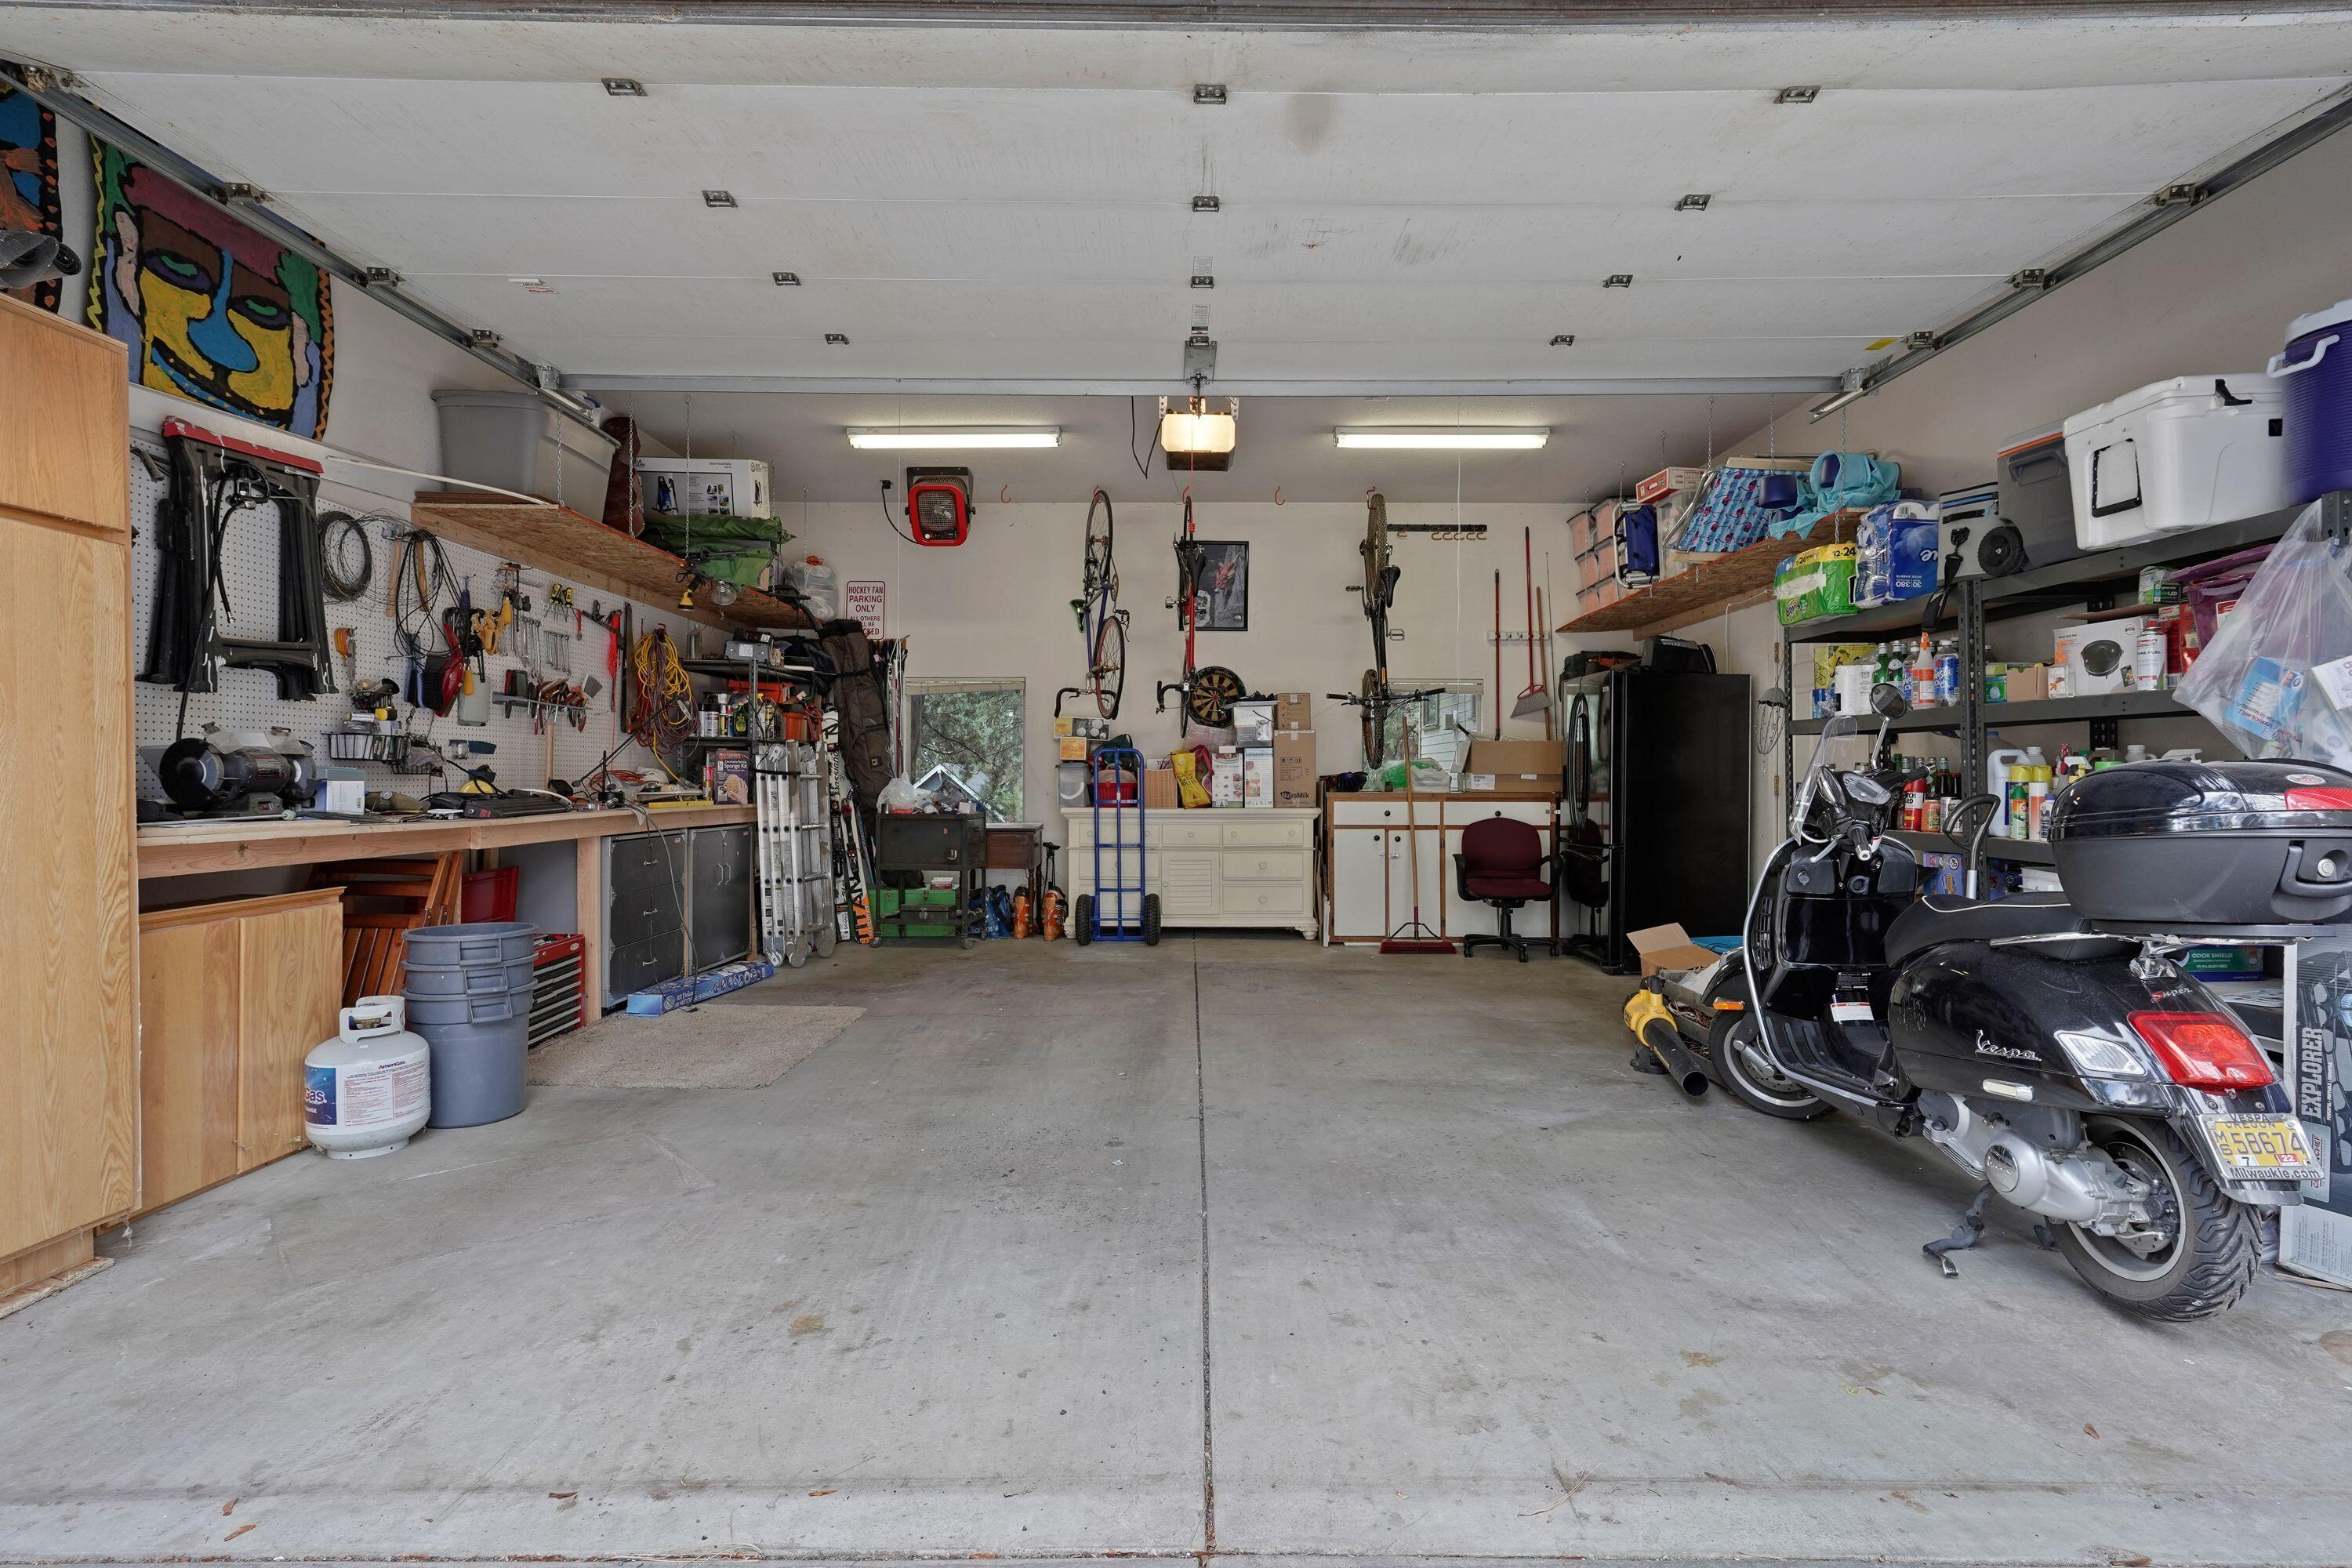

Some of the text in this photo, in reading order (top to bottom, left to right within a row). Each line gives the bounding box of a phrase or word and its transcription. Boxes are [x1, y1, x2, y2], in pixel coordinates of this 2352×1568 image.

[1279, 791, 1310, 800] NuraMilk
[2151, 988, 2194, 1004] Super
[1975, 1029, 2042, 1062] Vespa
[378, 1060, 406, 1070] AmeriGas
[2301, 1026, 2323, 1119] EXPLORER
[2230, 1113, 2270, 1122] VESPA
[2230, 1132, 2306, 1155] 58674
[2241, 1156, 2250, 1166] 7
[2230, 1167, 2321, 1179] Milwaukie.com
